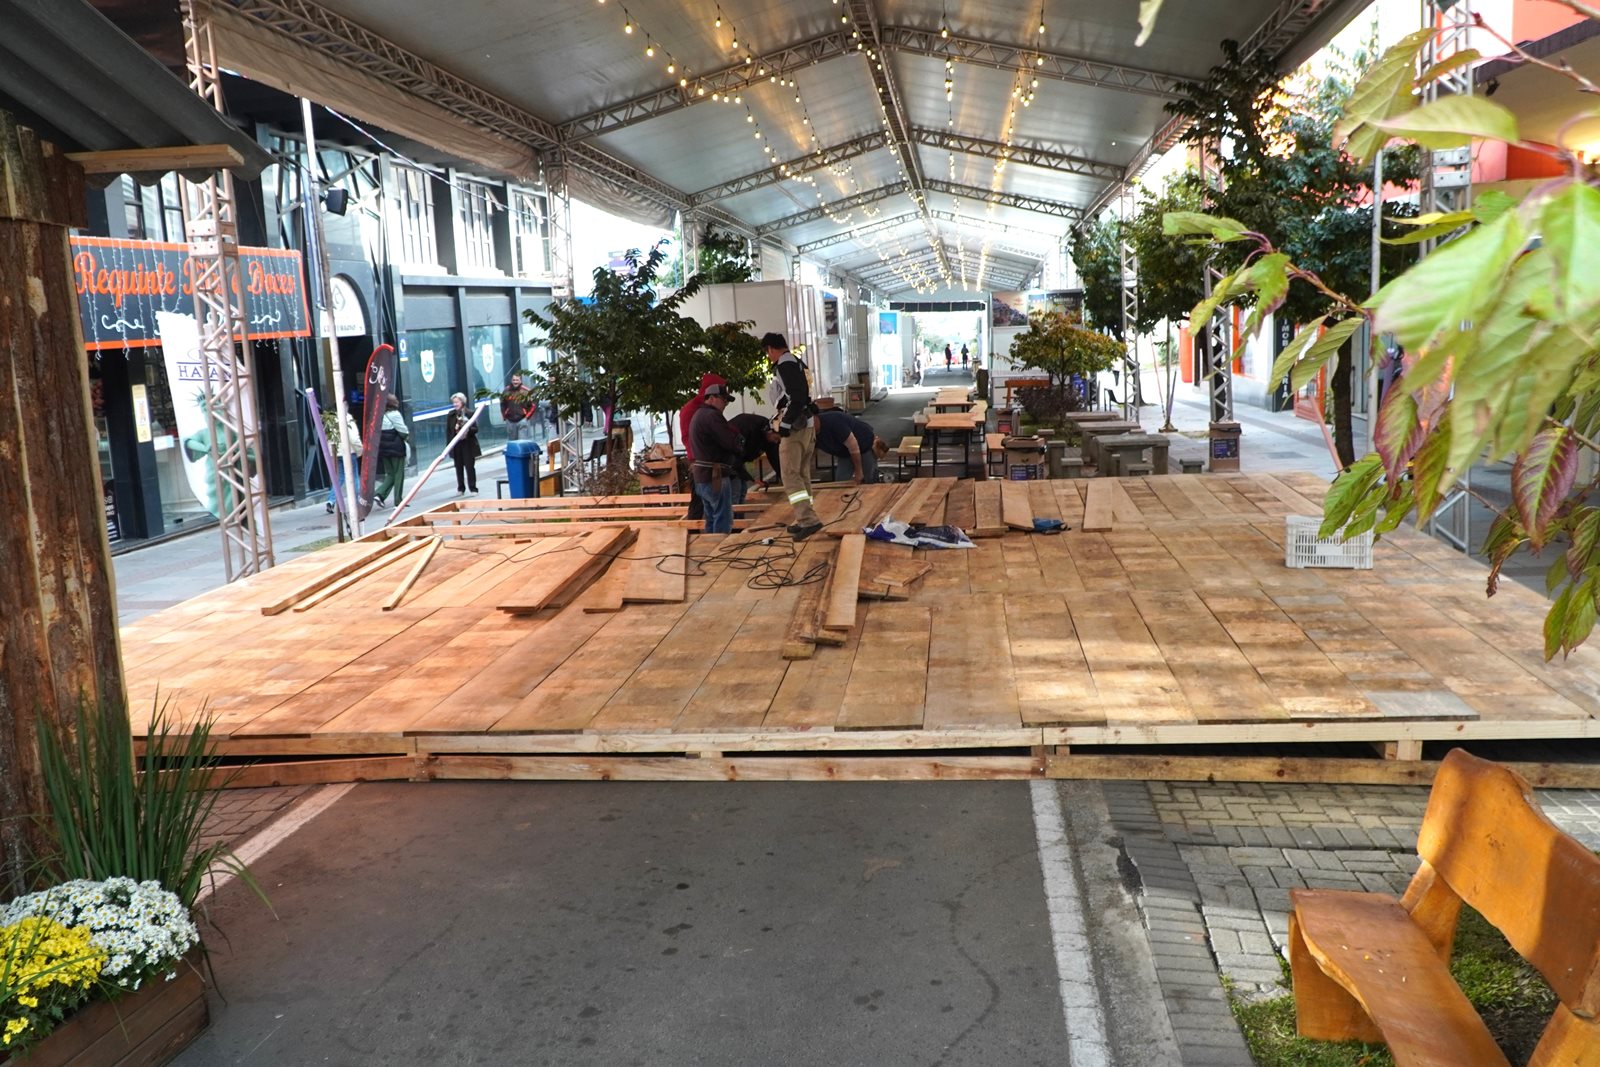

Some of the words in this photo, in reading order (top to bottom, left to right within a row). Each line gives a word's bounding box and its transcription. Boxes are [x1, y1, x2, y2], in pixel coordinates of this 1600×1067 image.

[74, 251, 176, 308] Requinte
[247, 261, 294, 295] Doces
[178, 365, 232, 379] HAAN
[1281, 319, 1290, 399] IMOBRIA
